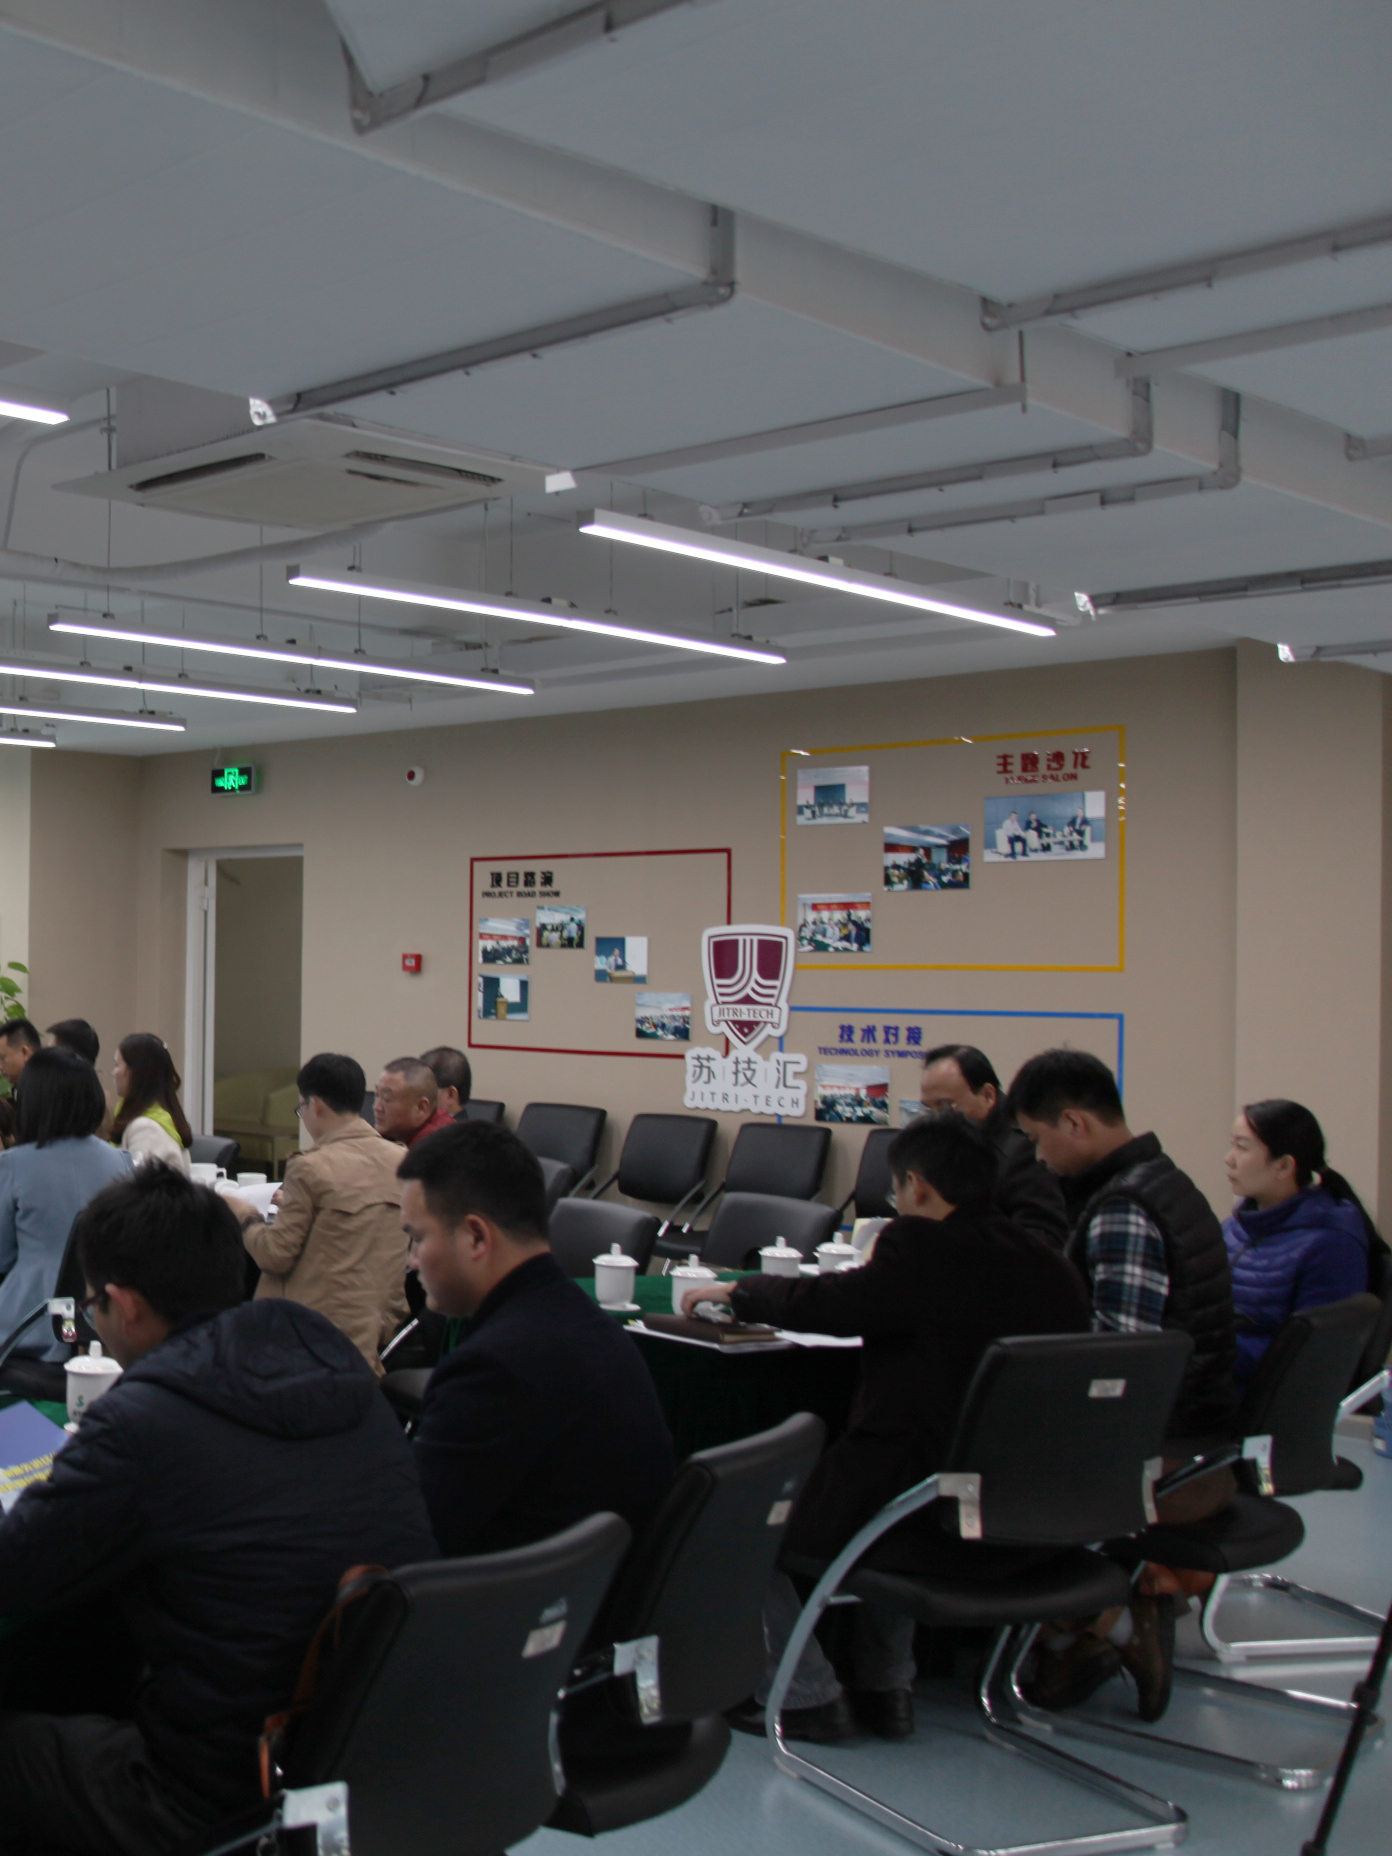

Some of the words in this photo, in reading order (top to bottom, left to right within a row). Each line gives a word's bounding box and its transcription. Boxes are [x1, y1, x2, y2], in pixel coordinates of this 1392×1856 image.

[1041, 772, 1079, 783] SALON
[490, 870, 554, 888] 项目路演
[718, 1006, 774, 1019] JITRI-TECH
[838, 1024, 923, 1046] 技术对接
[817, 1046, 881, 1058] TECHNOLOGY
[691, 1054, 801, 1089] 苏技汇
[690, 1090, 799, 1108] JITRI-TECH
